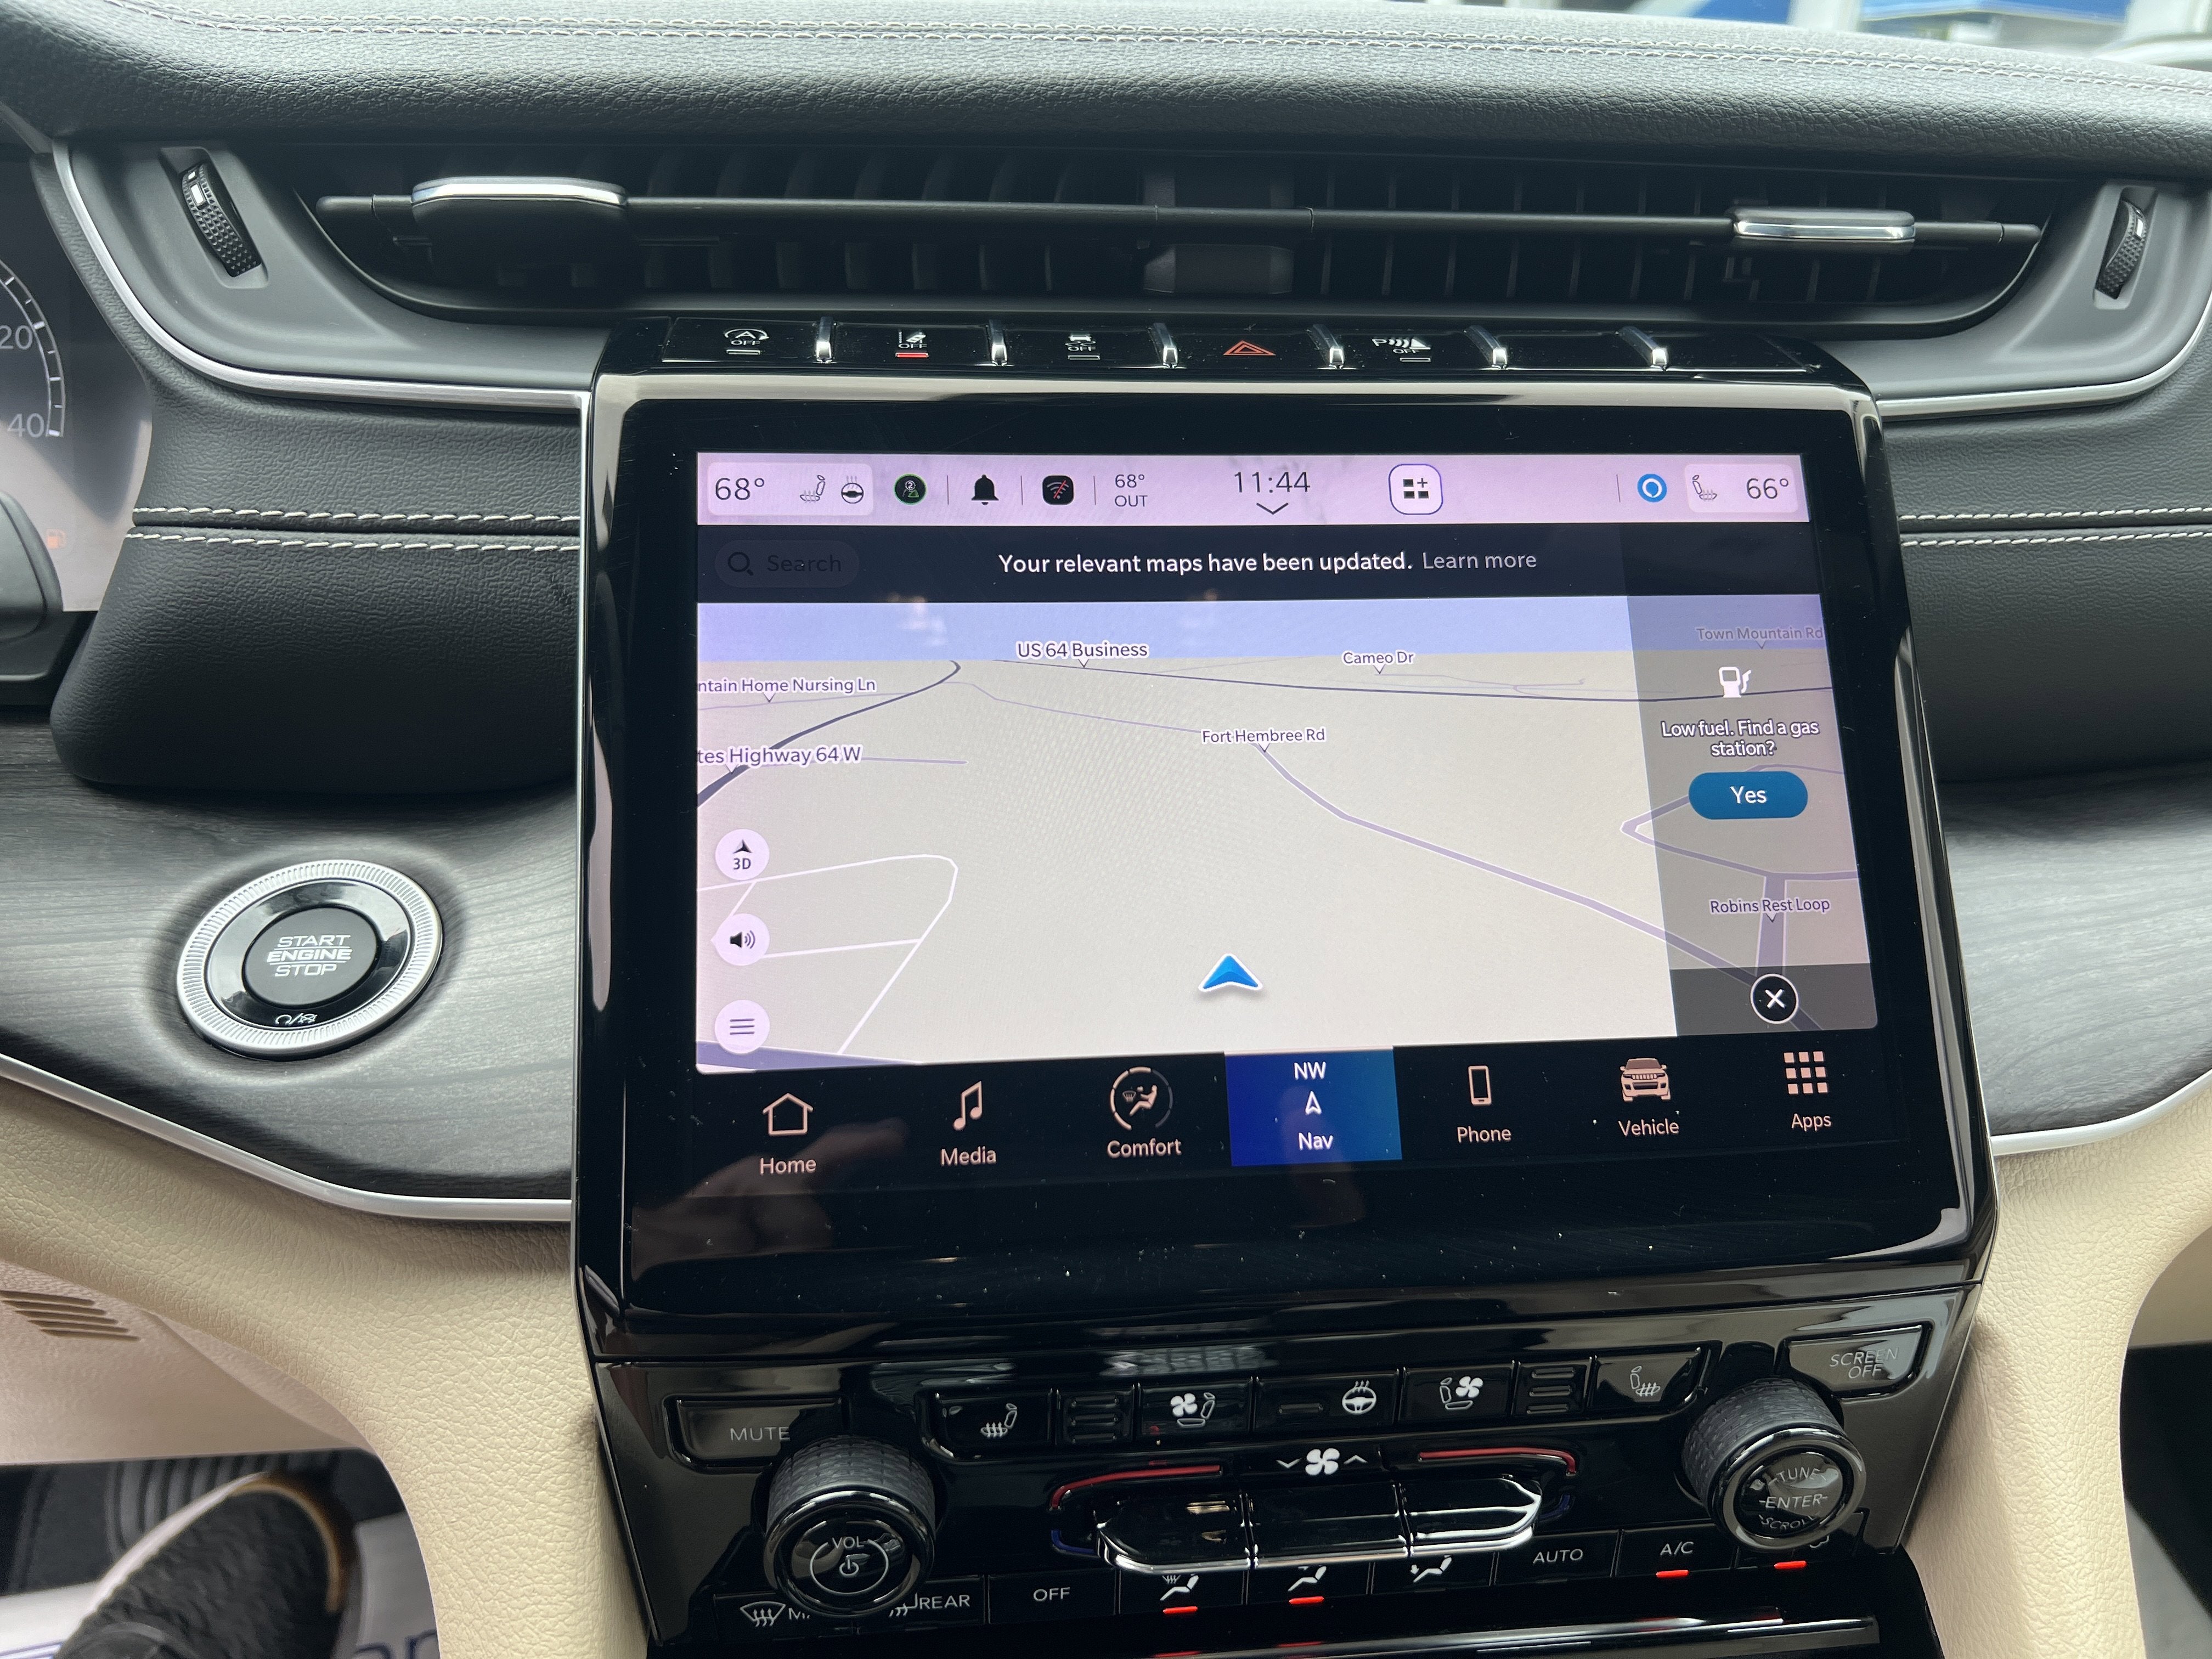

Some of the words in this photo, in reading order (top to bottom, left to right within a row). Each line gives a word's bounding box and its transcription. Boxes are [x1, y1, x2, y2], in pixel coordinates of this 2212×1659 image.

[715, 478, 764, 500] 68°
[1115, 475, 1144, 488] 68°
[1234, 472, 1311, 493] 11:44
[1746, 478, 1789, 500] 66°
[1115, 495, 1148, 507] OUT
[768, 554, 842, 572] Search
[999, 555, 1049, 572] Your
[1056, 554, 1141, 572] relevant
[1147, 557, 1203, 575] maps
[1209, 553, 1257, 571] have
[1263, 553, 1313, 571] been
[1319, 552, 1412, 574] updated.
[1423, 552, 1479, 568] Learn
[1485, 555, 1537, 568] more
[1697, 628, 1734, 640] Town
[1737, 627, 1802, 639] Mountain
[1807, 627, 1823, 639] Rd
[1018, 644, 1042, 657] US
[1045, 642, 1068, 657] 64
[1073, 641, 1148, 657] Business
[1343, 652, 1393, 664] Cameo
[1397, 651, 1414, 663] Dr
[698, 679, 737, 692] ntain
[742, 680, 788, 692] Home
[793, 678, 854, 693] Nursing
[858, 679, 876, 691] Ln
[1203, 730, 1232, 743] Fort
[1235, 729, 1302, 742] Hembree
[1307, 727, 1325, 741] Rd
[1662, 721, 1695, 737] Low
[1699, 720, 1734, 736] fuel.
[1738, 719, 1774, 736] Find
[1777, 724, 1787, 735] a
[1791, 722, 1819, 738] gas
[1711, 740, 1775, 756] station?
[730, 748, 811, 766] Highway
[816, 747, 839, 761] 64
[843, 747, 861, 760] W
[1730, 786, 1767, 804] Yes
[733, 858, 751, 870] 3D
[1711, 900, 1759, 913] Robins
[1763, 899, 1792, 911] Rest
[1796, 898, 1830, 912] Loop
[277, 934, 351, 947] START
[267, 949, 353, 963] ENGINE
[275, 963, 337, 977] STOP
[1294, 1062, 1326, 1079] NW
[1618, 1118, 1679, 1137] Vehicle
[1791, 1112, 1832, 1131] Apps
[1299, 1131, 1333, 1150] Nav
[1458, 1125, 1512, 1144] Phone
[940, 1146, 997, 1166] Media
[1107, 1138, 1182, 1159] Comfort
[759, 1157, 817, 1175] Home
[1830, 1347, 1899, 1367] SCREEN
[1848, 1363, 1884, 1379] OFF
[730, 1426, 790, 1441] MUTE
[1776, 1466, 1820, 1483] TUNE
[832, 1536, 865, 1549] VOL
[1660, 1541, 1694, 1556] A/C
[1533, 1548, 1584, 1564] AUTO
[919, 1594, 970, 1610] REAR
[1034, 1587, 1071, 1601] OFF
